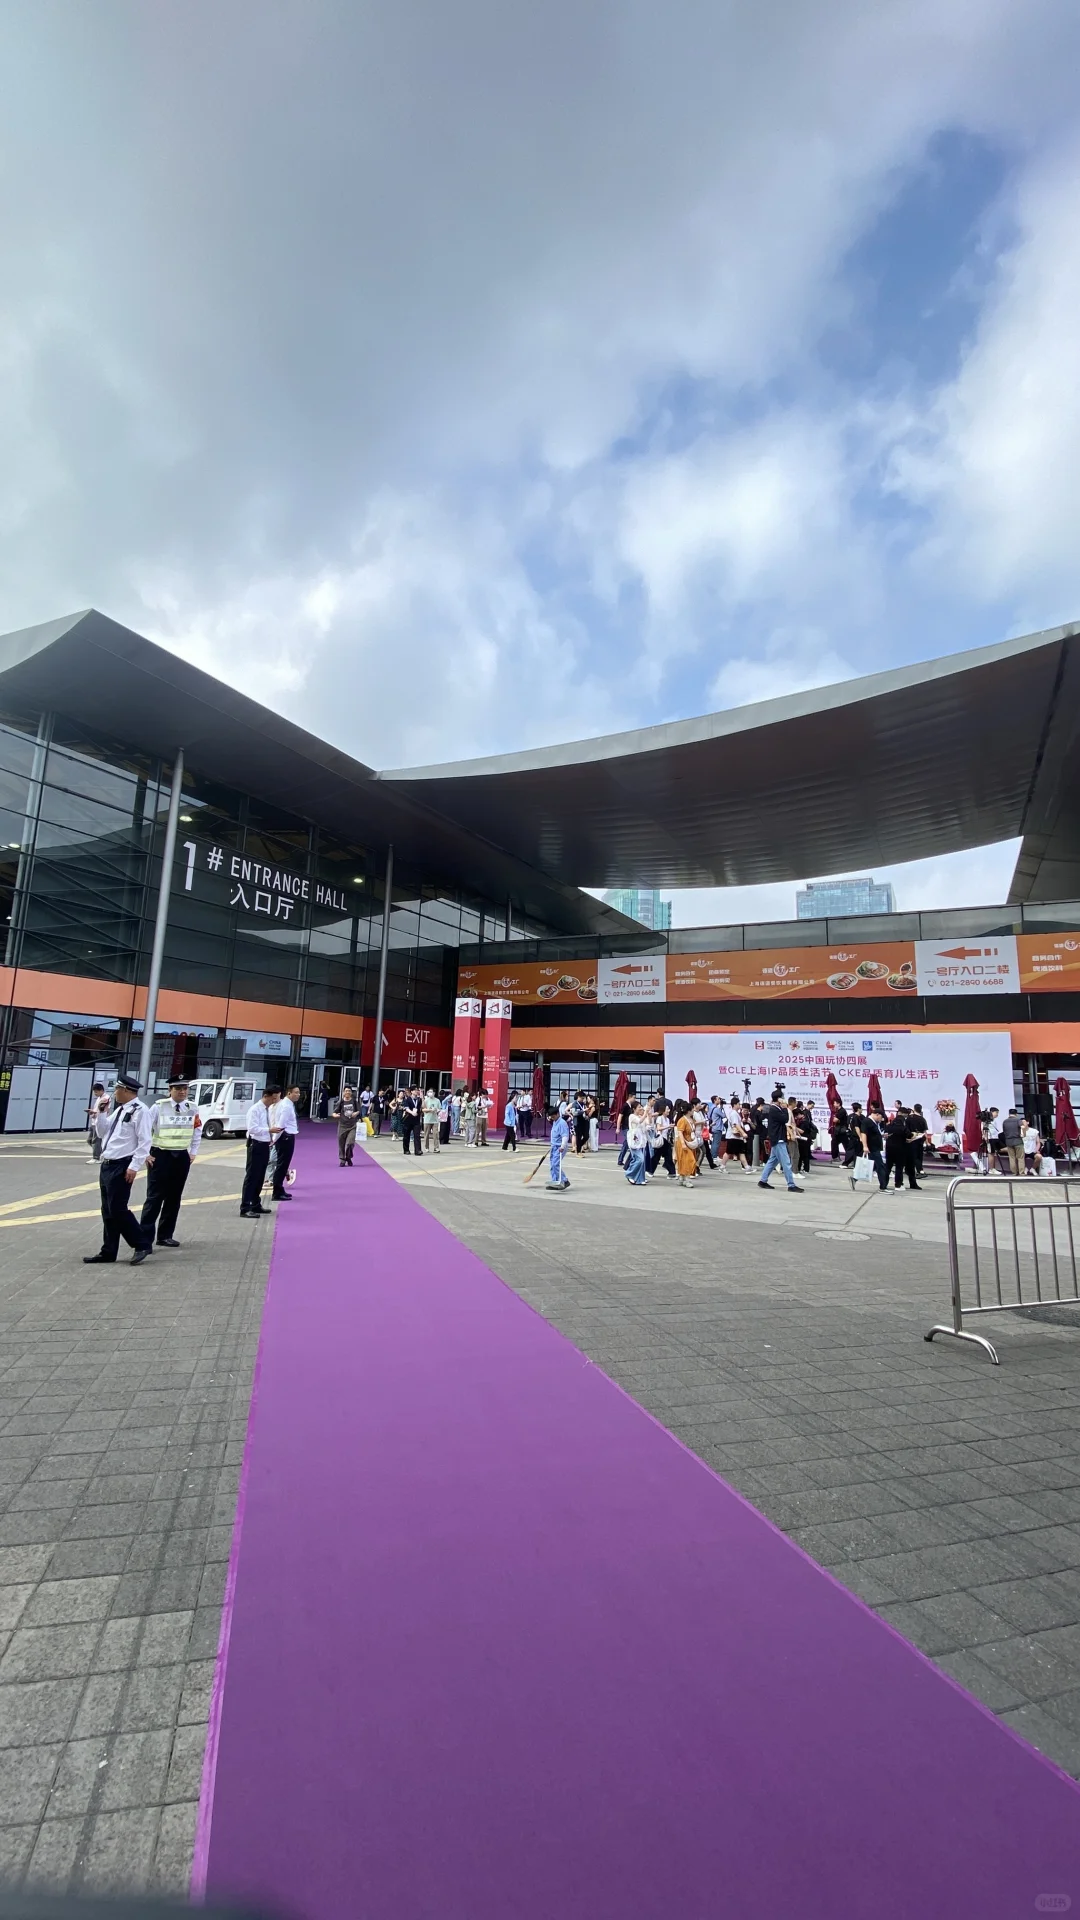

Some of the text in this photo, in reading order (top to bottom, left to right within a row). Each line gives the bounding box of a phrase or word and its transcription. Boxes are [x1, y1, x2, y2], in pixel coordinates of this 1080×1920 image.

[230, 856, 310, 899] ENTRANCE
[316, 884, 348, 911] HALL
[230, 883, 294, 920] 入口厅
[924, 965, 1010, 976] 一号厅入口二楼
[603, 978, 660, 989] 一号厅入口二楼
[940, 978, 1004, 987] 021-2890 6688
[405, 1027, 431, 1045] EXIT
[407, 1050, 428, 1064] 出口
[778, 1055, 868, 1065] 2025中国玩协四展
[838, 1068, 940, 1080] CKE品质育儿生活节
[810, 1080, 829, 1089] 开幕
